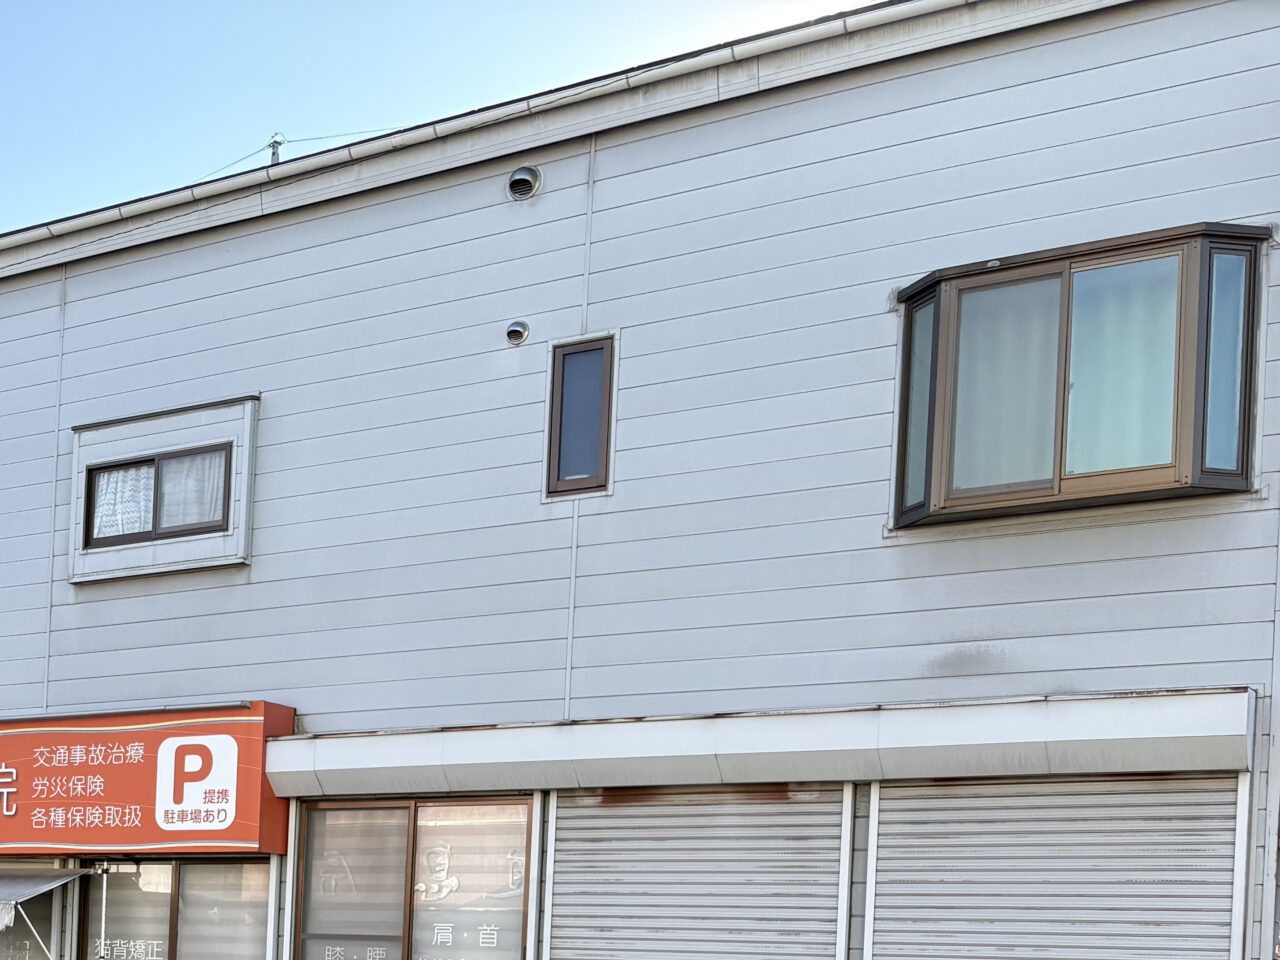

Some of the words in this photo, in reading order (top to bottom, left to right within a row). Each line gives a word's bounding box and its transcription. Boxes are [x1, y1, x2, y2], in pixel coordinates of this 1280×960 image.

[32, 742, 145, 768] 交通事故治療
[31, 774, 105, 799] 労災保険
[172, 743, 214, 805] P
[202, 788, 230, 805] 提携
[30, 804, 143, 829] 各種保険取扱
[163, 808, 228, 825] 駐車場あり
[94, 938, 164, 960] 猫背矯正
